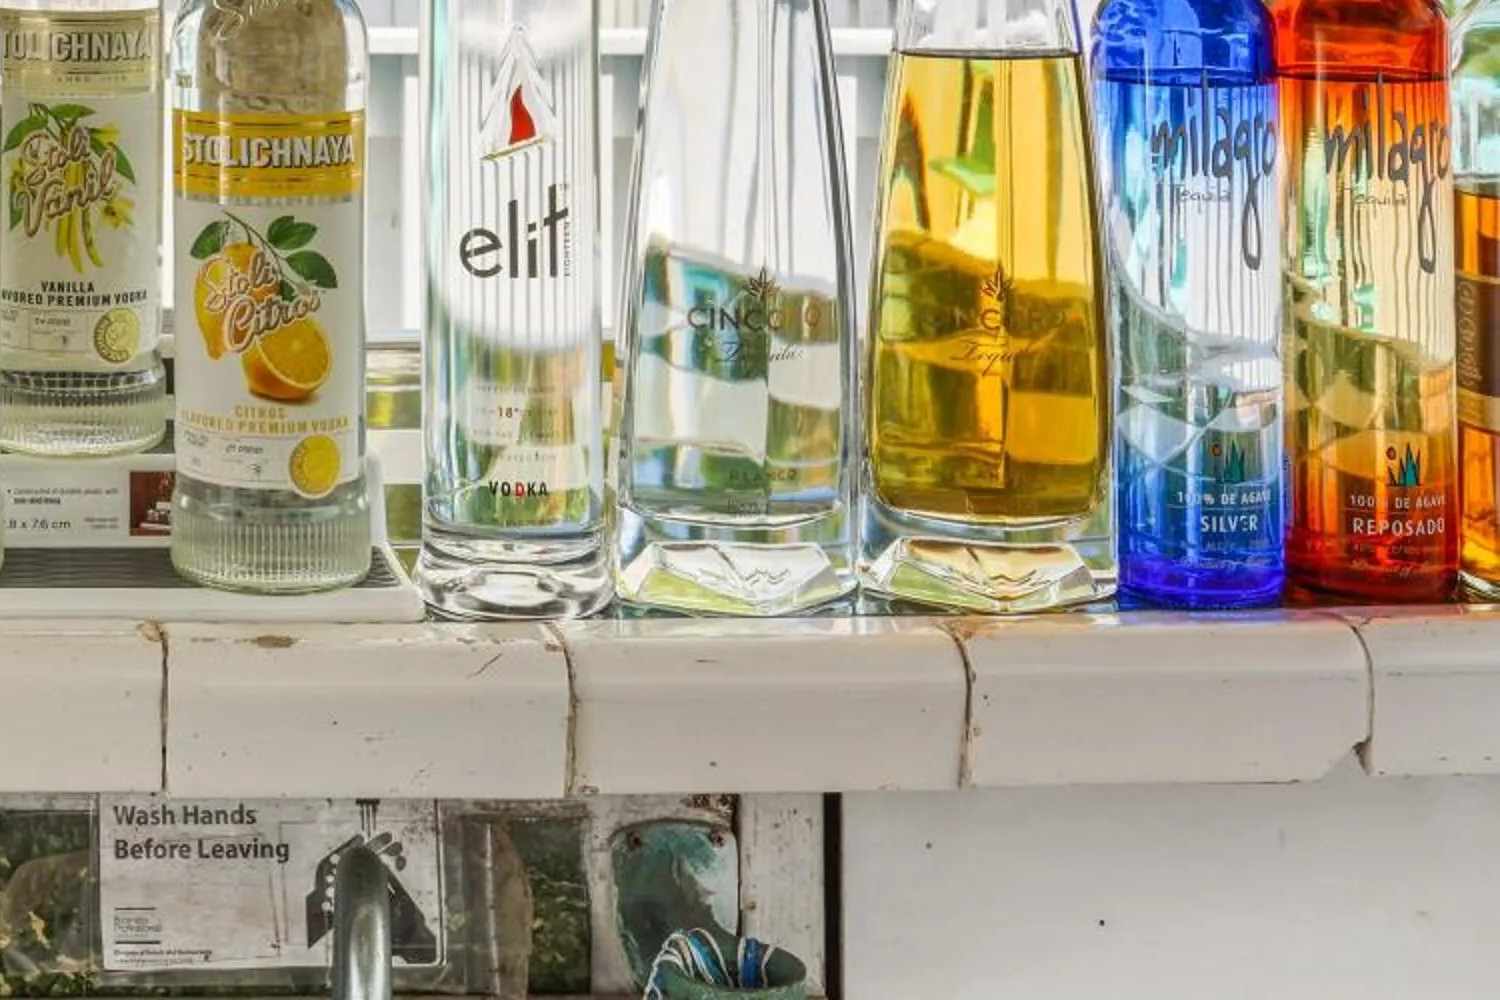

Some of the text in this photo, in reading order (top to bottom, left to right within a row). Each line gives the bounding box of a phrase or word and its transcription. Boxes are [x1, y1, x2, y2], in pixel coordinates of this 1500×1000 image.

[21, 126, 94, 187] Stoli
[184, 134, 356, 169] STOLICHNAYA
[1151, 68, 1277, 271] milagro
[1324, 68, 1451, 275] milagro
[459, 183, 569, 278] elit
[41, 280, 95, 293] VANILLA
[204, 251, 280, 312] Stoli
[47, 292, 111, 307] PREMIUM
[113, 289, 148, 304] VODKA
[182, 409, 349, 434] FLAVORED PREMIUM VODKA
[488, 480, 549, 498] VODKA
[1221, 493, 1237, 505] DE
[1395, 496, 1411, 509] DE
[52, 520, 71, 529] cm
[1201, 514, 1258, 533] SILVER
[1352, 516, 1446, 536] REPOSADO
[113, 803, 257, 826] Wash Hands
[115, 837, 290, 864] Before Leaving
